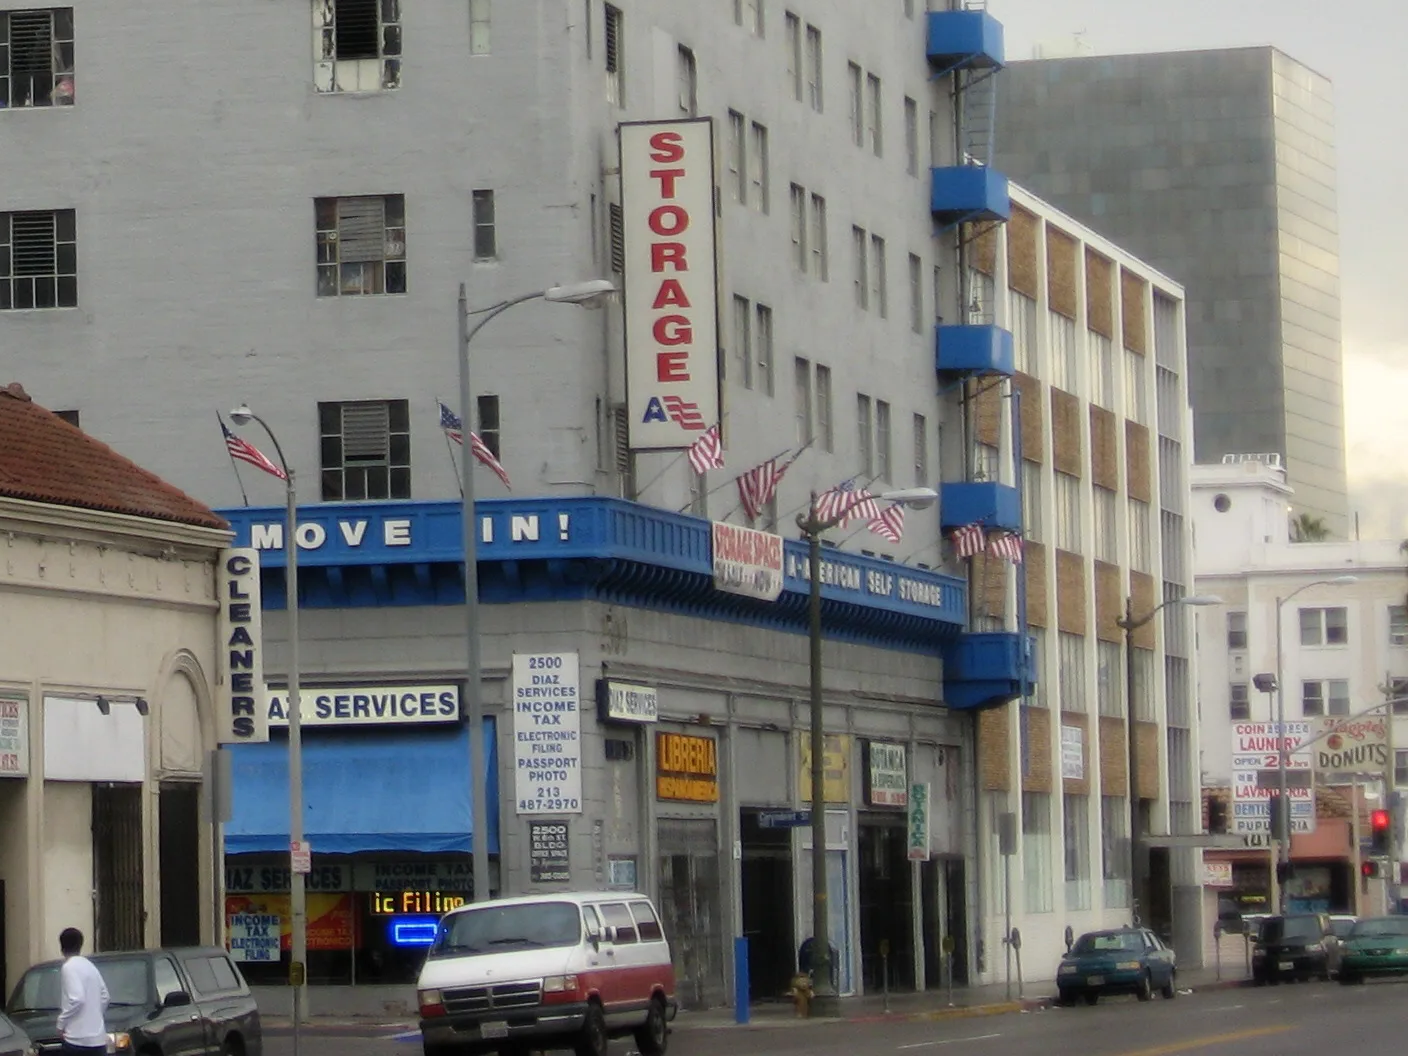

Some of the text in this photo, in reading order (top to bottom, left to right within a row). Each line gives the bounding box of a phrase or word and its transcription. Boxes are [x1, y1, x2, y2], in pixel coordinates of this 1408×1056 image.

[648, 132, 693, 382] STORAGE
[251, 514, 569, 550] MOVE IN!
[788, 554, 861, 590] A-AERICAN
[867, 570, 892, 595] SELF
[899, 576, 941, 607] STORAGE
[226, 555, 256, 738] CLEANERS
[529, 657, 562, 669] 2500
[532, 675, 560, 685] DIAZ
[517, 687, 576, 698] SERVICES
[315, 691, 456, 720] SERVICES
[517, 701, 576, 712] INCOME
[532, 715, 561, 725] TAX
[1235, 724, 1265, 735] COIN
[517, 731, 576, 742] ELECTRONIC
[532, 743, 562, 754] FILING
[662, 734, 717, 776] LIBRERIA
[1319, 744, 1387, 769] DONUTS
[518, 757, 577, 769] PASSPORT
[1234, 757, 1261, 766] OPEN
[529, 771, 567, 782] PHOTO
[537, 787, 560, 798] 213
[519, 799, 578, 811] 487-2970
[532, 825, 566, 834] 2500
[1237, 821, 1310, 832] PUPURIA
[375, 863, 472, 876] INCOME TAX
[375, 878, 431, 890] PASSPORT
[375, 892, 394, 913] ic
[231, 915, 279, 926] INCOME
[245, 927, 270, 937] TAX
[231, 938, 279, 949] ELECTRONIC
[245, 949, 271, 961] FILING
